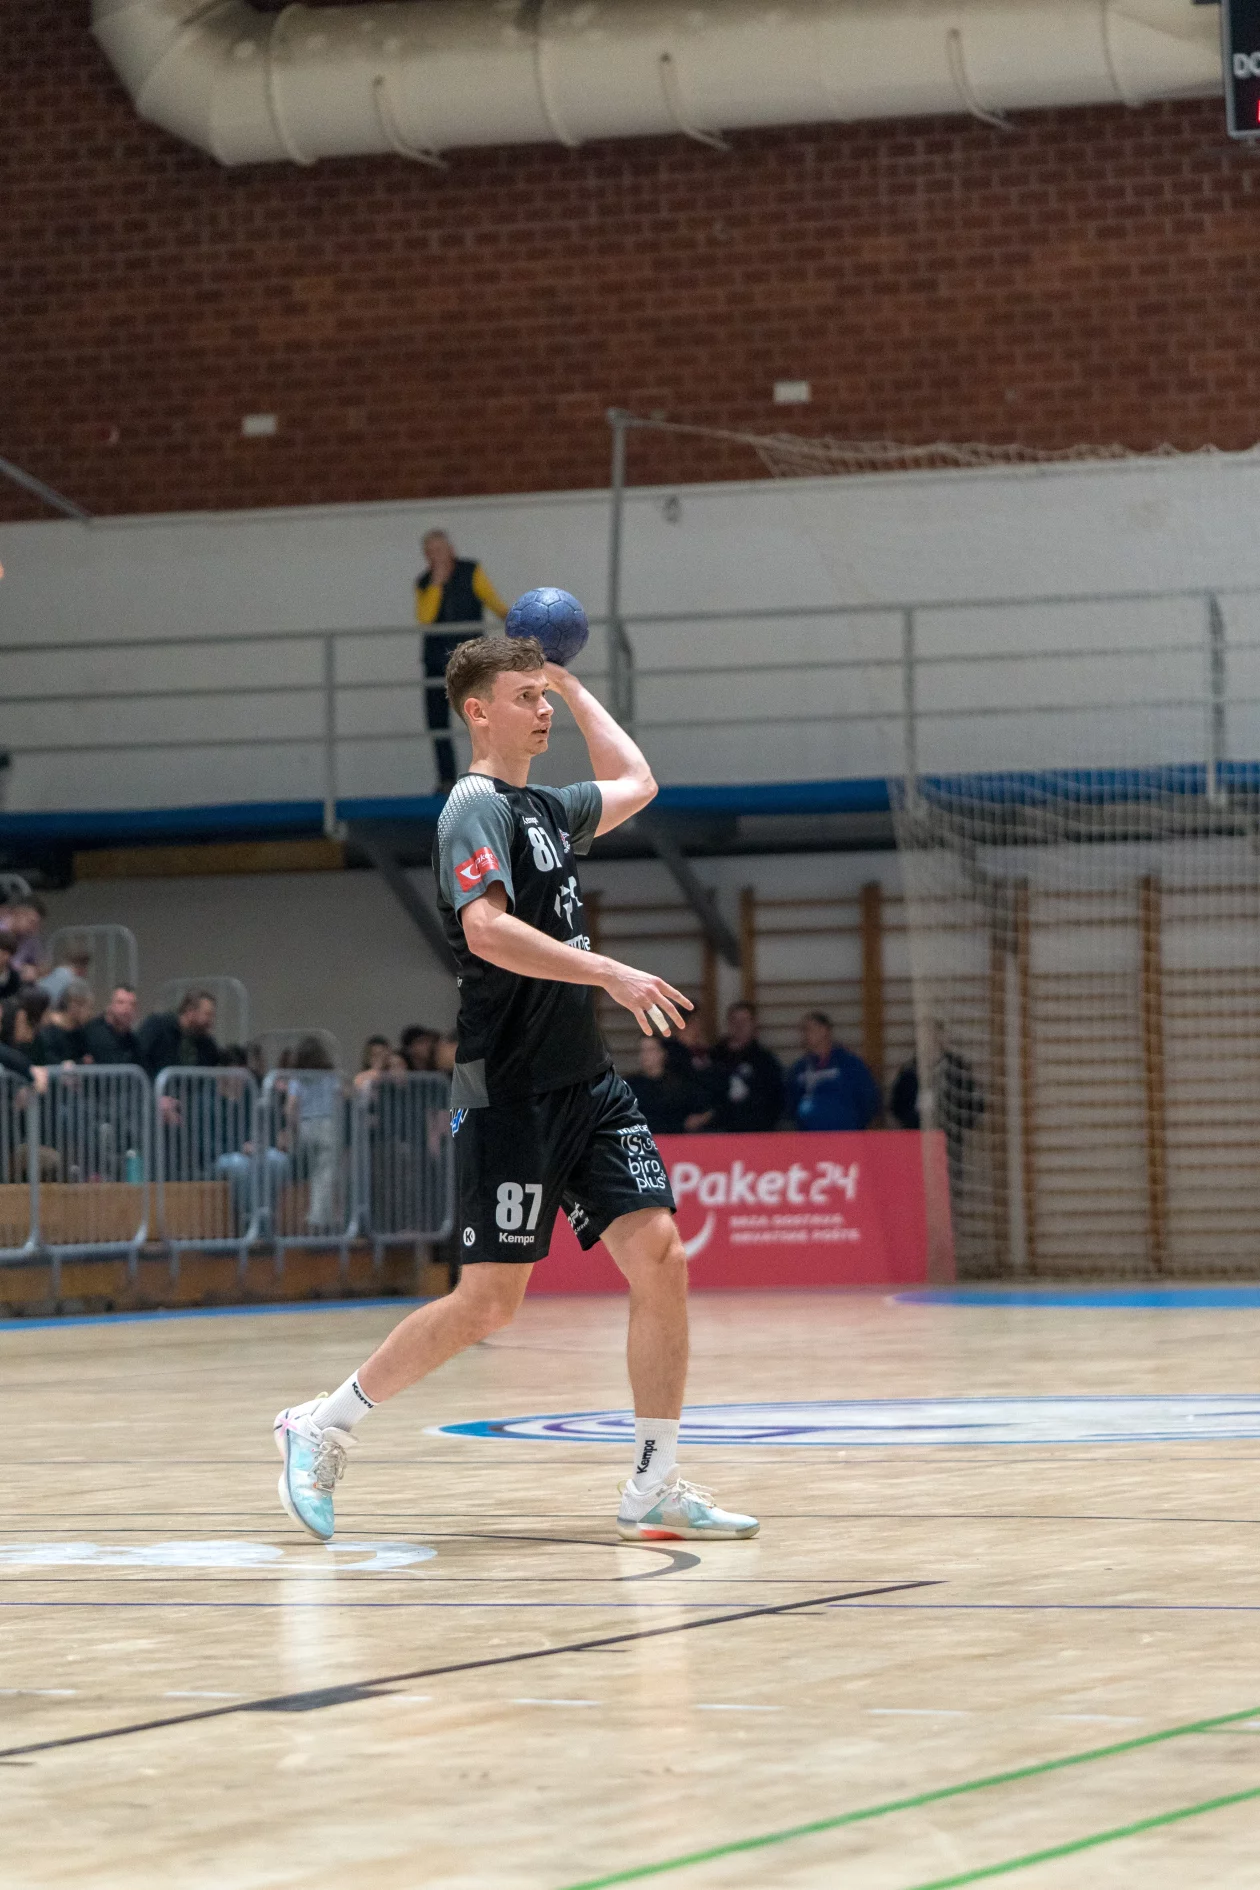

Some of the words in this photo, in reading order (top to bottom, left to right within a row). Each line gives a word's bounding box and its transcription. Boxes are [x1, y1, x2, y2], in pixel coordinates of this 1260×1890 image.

[527, 826, 563, 872] 87
[627, 1156, 661, 1176] biro
[495, 1181, 542, 1231] 87
[498, 1232, 535, 1246] Kempa
[636, 1439, 658, 1475] Kempa
